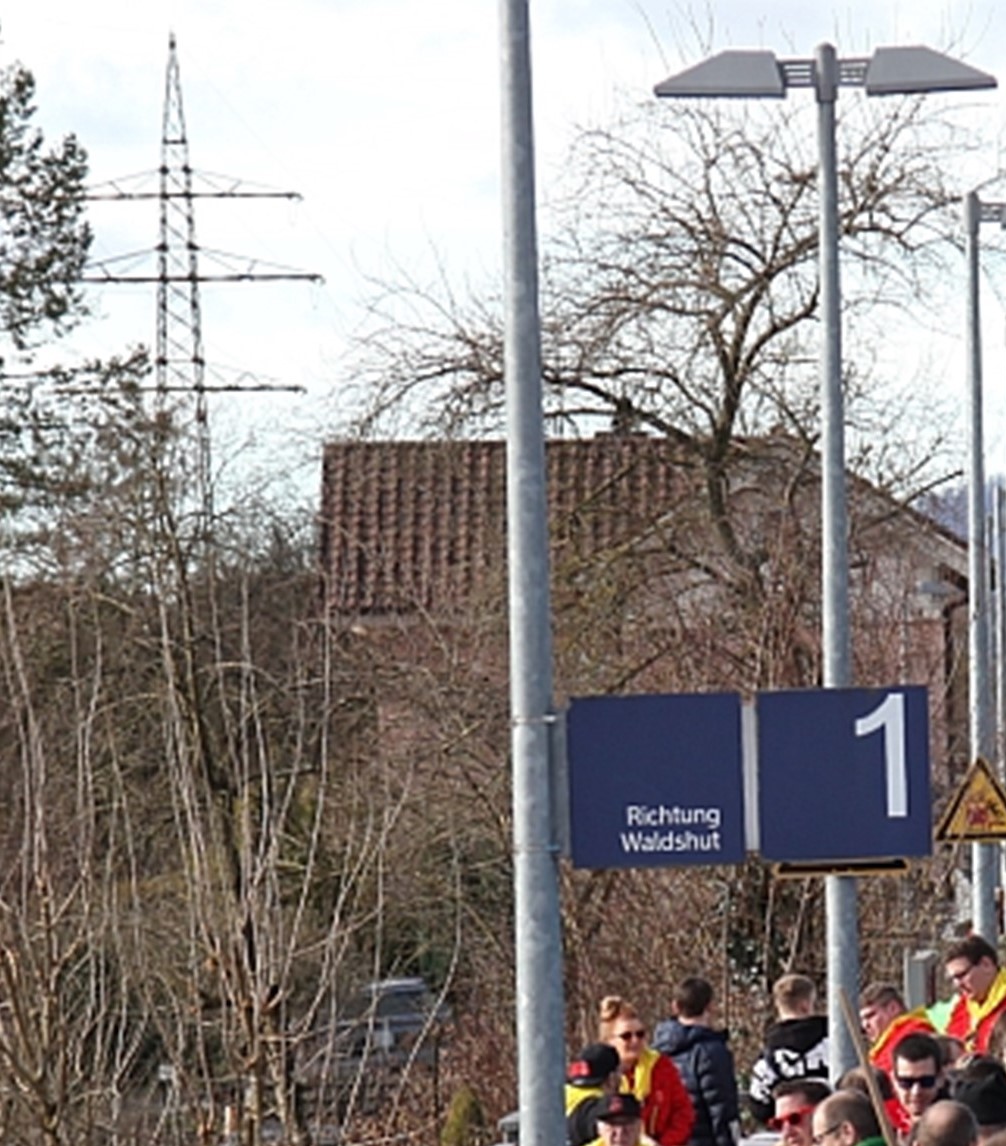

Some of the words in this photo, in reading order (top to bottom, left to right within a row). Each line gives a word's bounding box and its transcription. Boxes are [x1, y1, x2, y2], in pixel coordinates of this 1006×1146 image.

[855, 693, 907, 818] 1
[627, 805, 720, 829] Richtung
[620, 831, 720, 852] Waldshut
